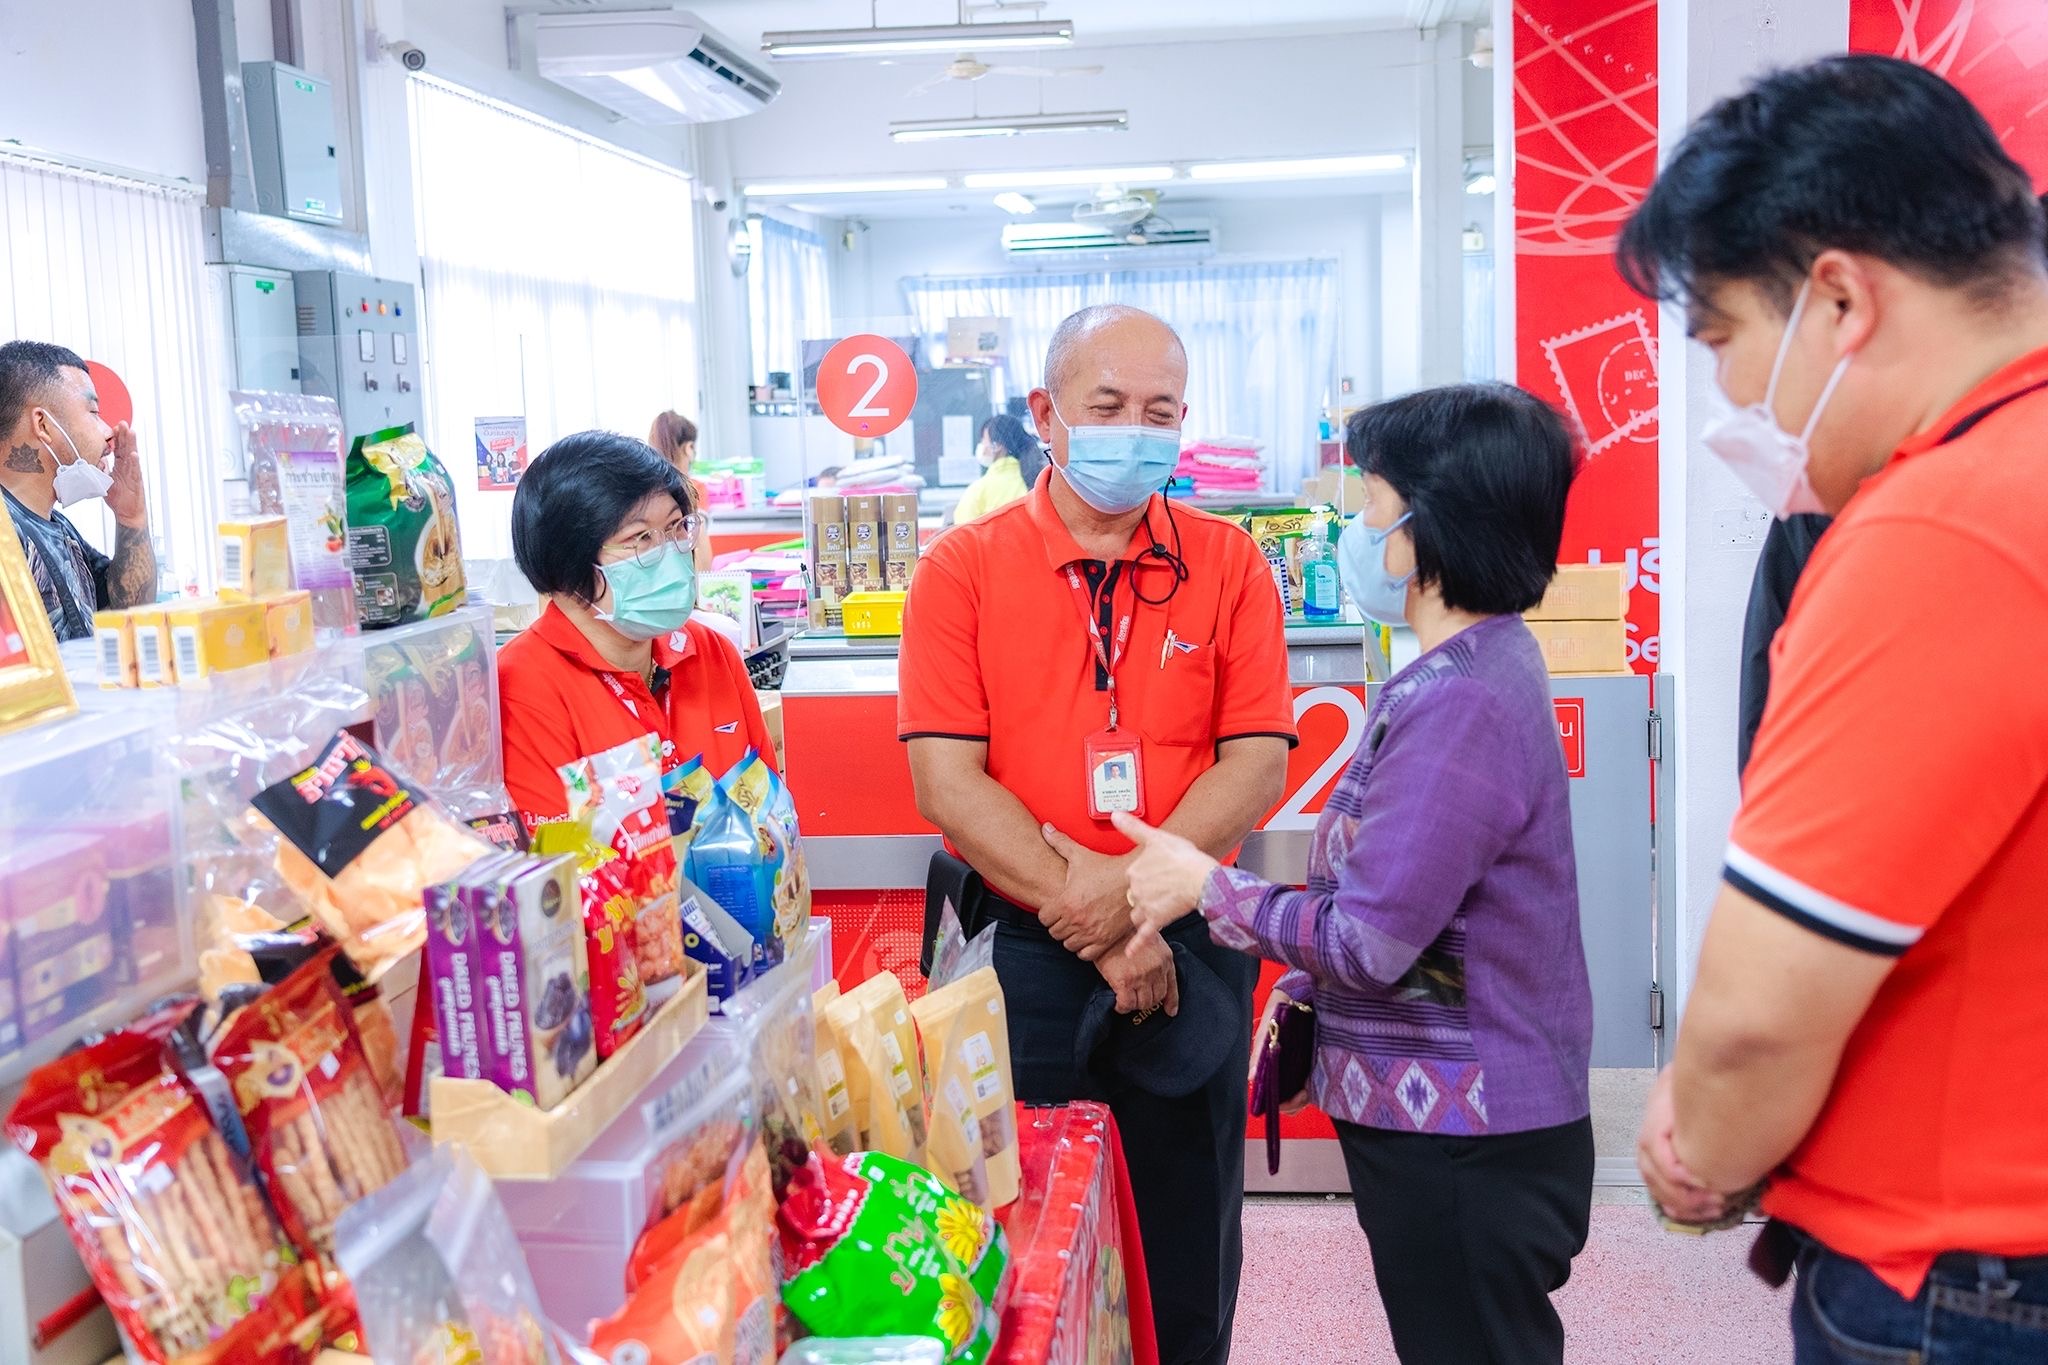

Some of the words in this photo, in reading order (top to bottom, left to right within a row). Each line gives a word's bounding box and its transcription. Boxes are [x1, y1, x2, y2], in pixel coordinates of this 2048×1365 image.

[846, 354, 890, 418] 2
[1624, 369, 1647, 382] DEC
[1263, 686, 1366, 831] 2
[451, 952, 473, 1009] DRIED
[499, 951, 521, 1009] DRIED
[505, 1010, 528, 1081] PRUNES
